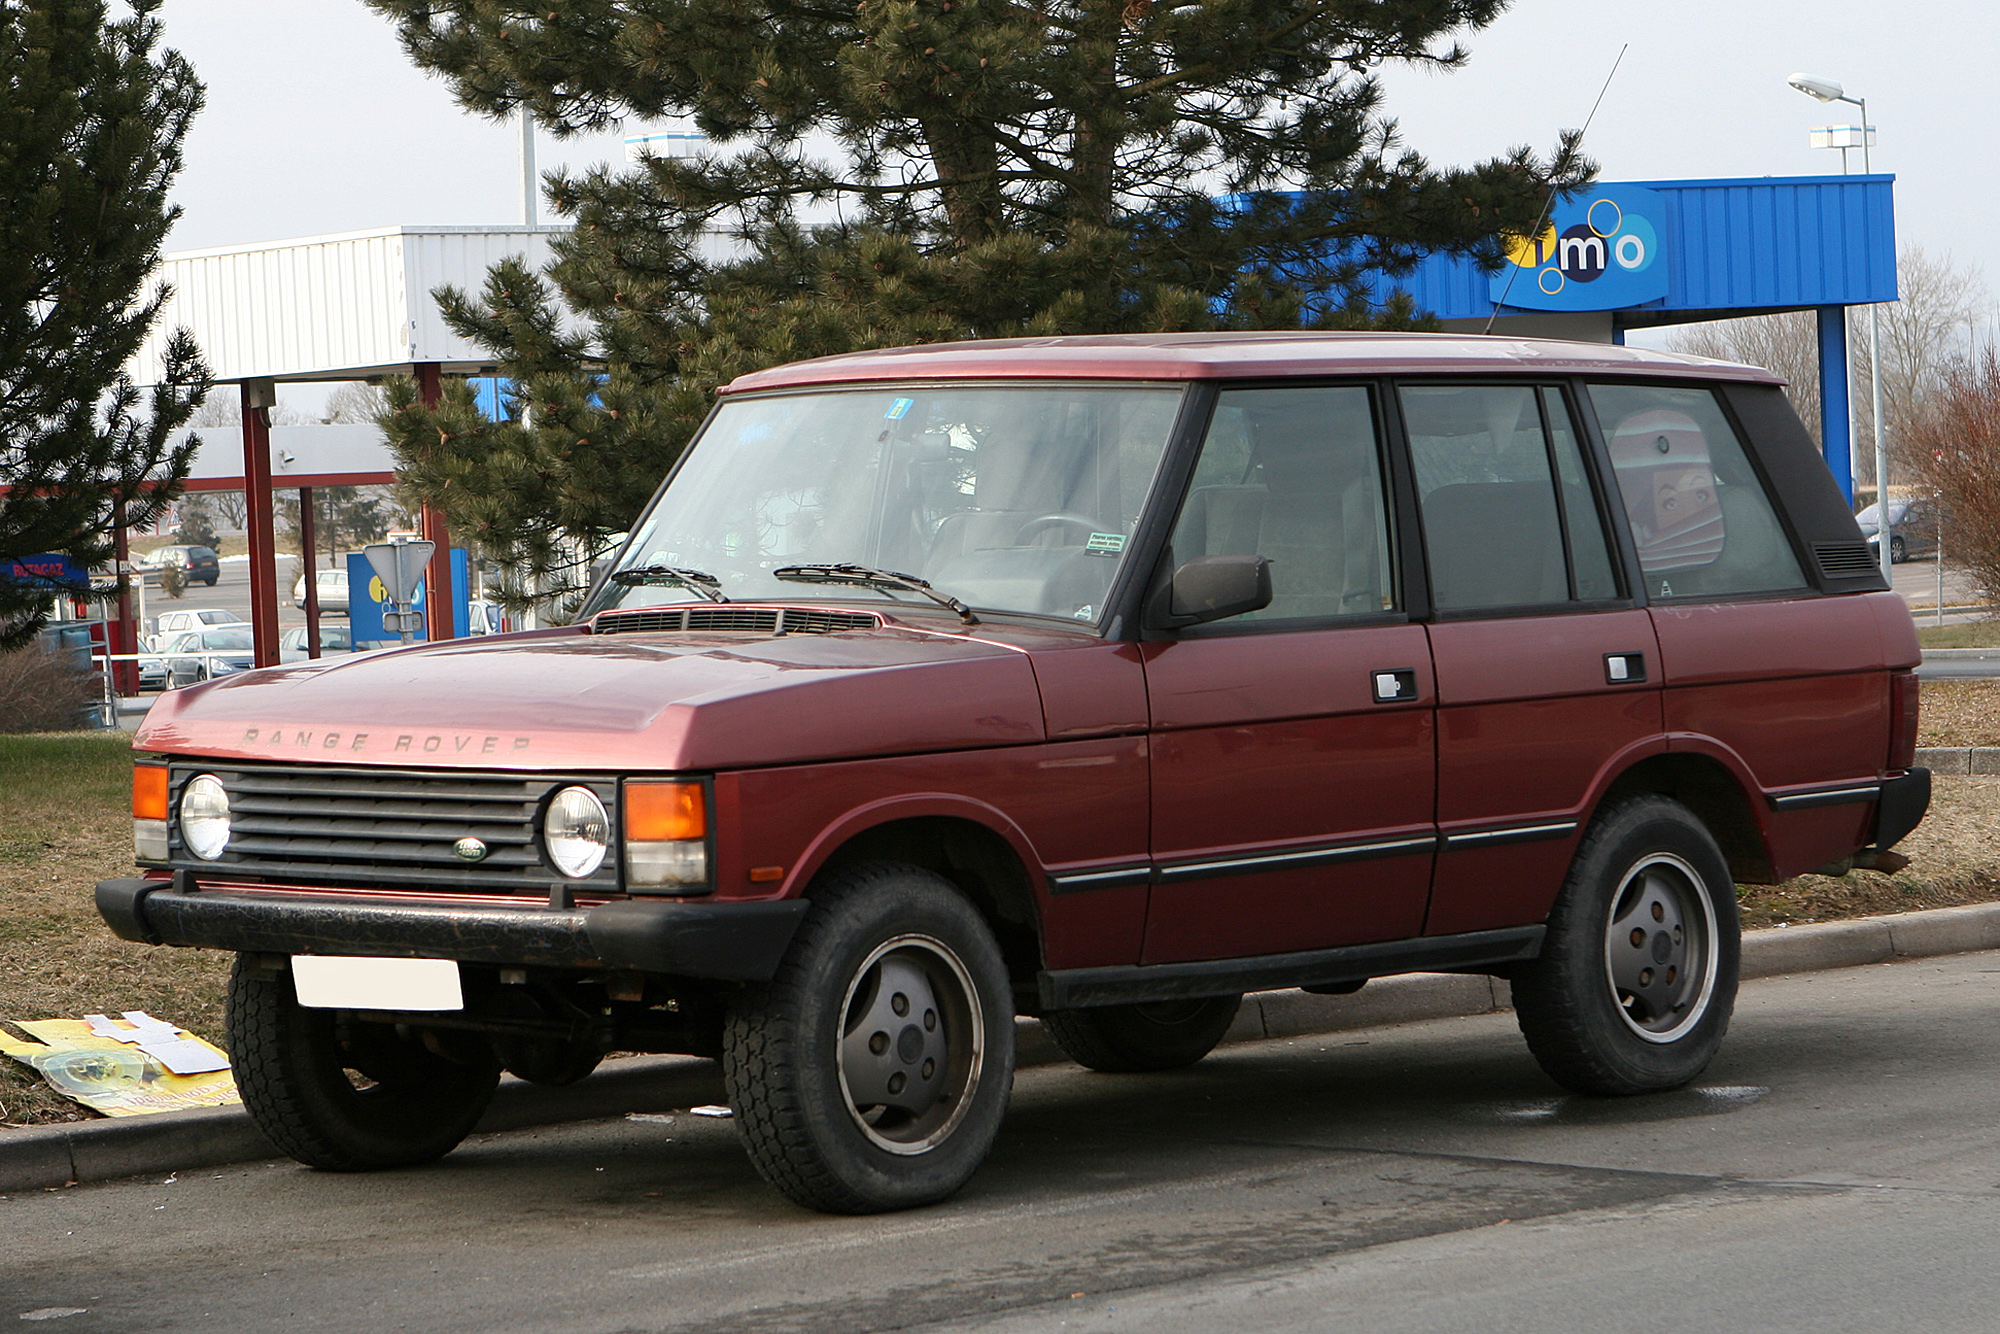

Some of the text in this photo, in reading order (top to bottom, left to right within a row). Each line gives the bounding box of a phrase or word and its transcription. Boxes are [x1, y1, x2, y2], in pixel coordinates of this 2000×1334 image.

[12, 562, 65, 577] BUTAGAZ
[242, 728, 531, 754] RANGE ROVER
